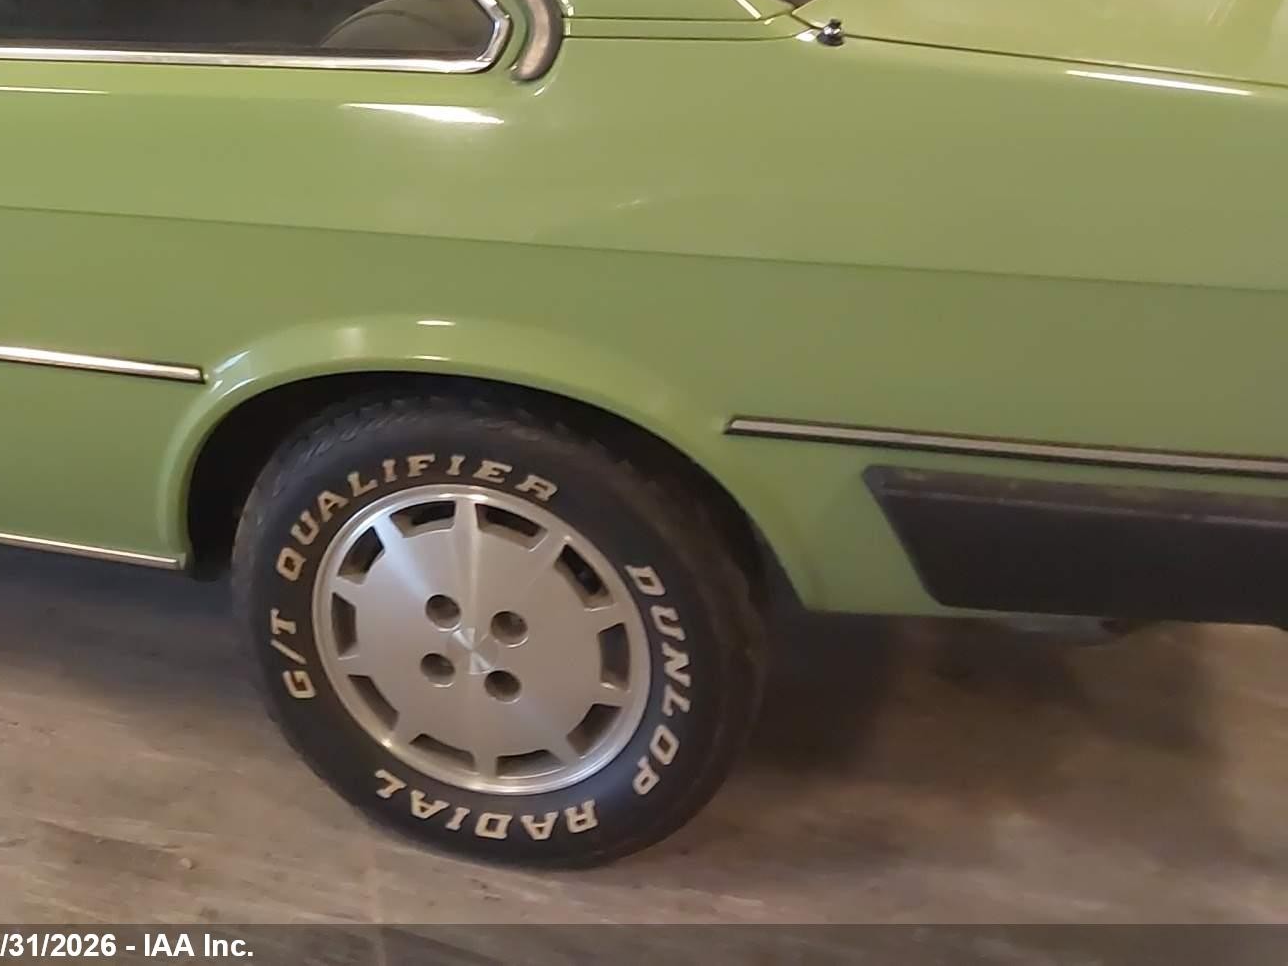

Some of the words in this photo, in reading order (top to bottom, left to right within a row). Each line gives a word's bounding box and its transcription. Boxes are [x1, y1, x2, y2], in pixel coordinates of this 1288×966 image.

[276, 453, 560, 582] QUALIFIER
[269, 609, 317, 700] G/T
[624, 564, 692, 795] DUNLOP
[375, 769, 600, 841] RADIAL
